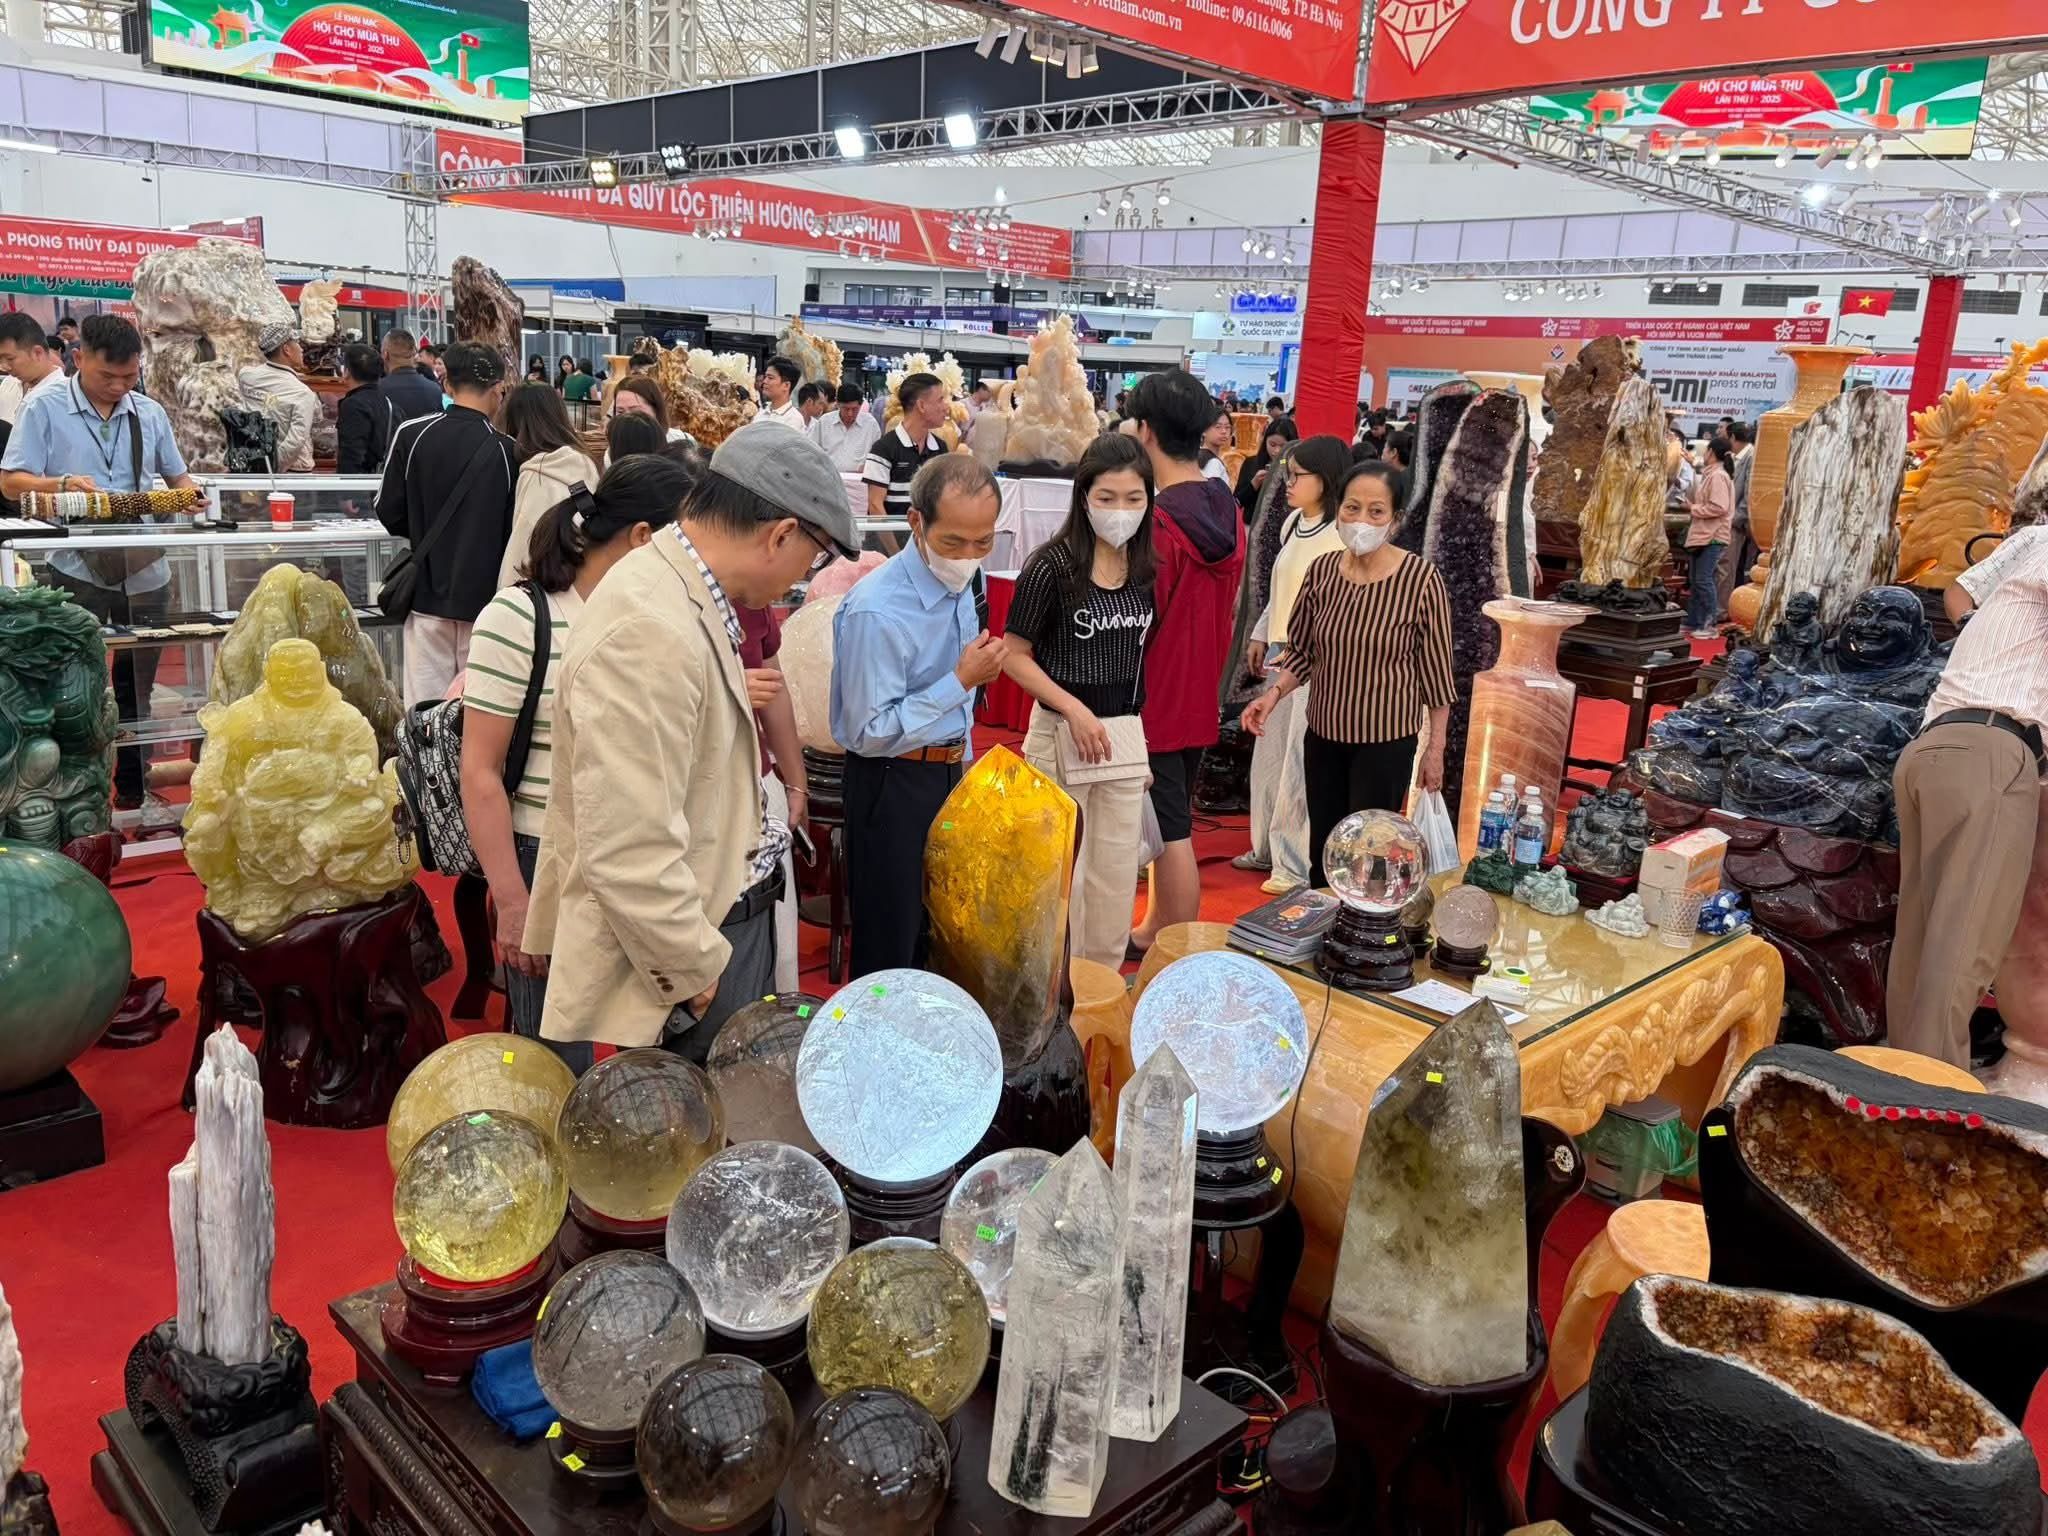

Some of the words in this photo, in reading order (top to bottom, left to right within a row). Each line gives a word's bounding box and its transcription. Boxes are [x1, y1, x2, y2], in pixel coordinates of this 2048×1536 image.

[1232, 6, 1293, 40] 09.6116.0066
[1309, 3, 1324, 24] Hà
[1325, 9, 1344, 33] Nội
[381, 34, 400, 46] THU
[1780, 79, 1804, 91] THU
[671, 182, 705, 223] LỘC
[759, 200, 815, 231] HƯƠNG
[7, 231, 63, 249] PHONG
[66, 233, 102, 252] THỦY
[107, 239, 132, 257] ĐẠI
[1710, 380, 1738, 390] press
[1742, 378, 1777, 390] metal
[1074, 608, 1153, 646] Sunny
